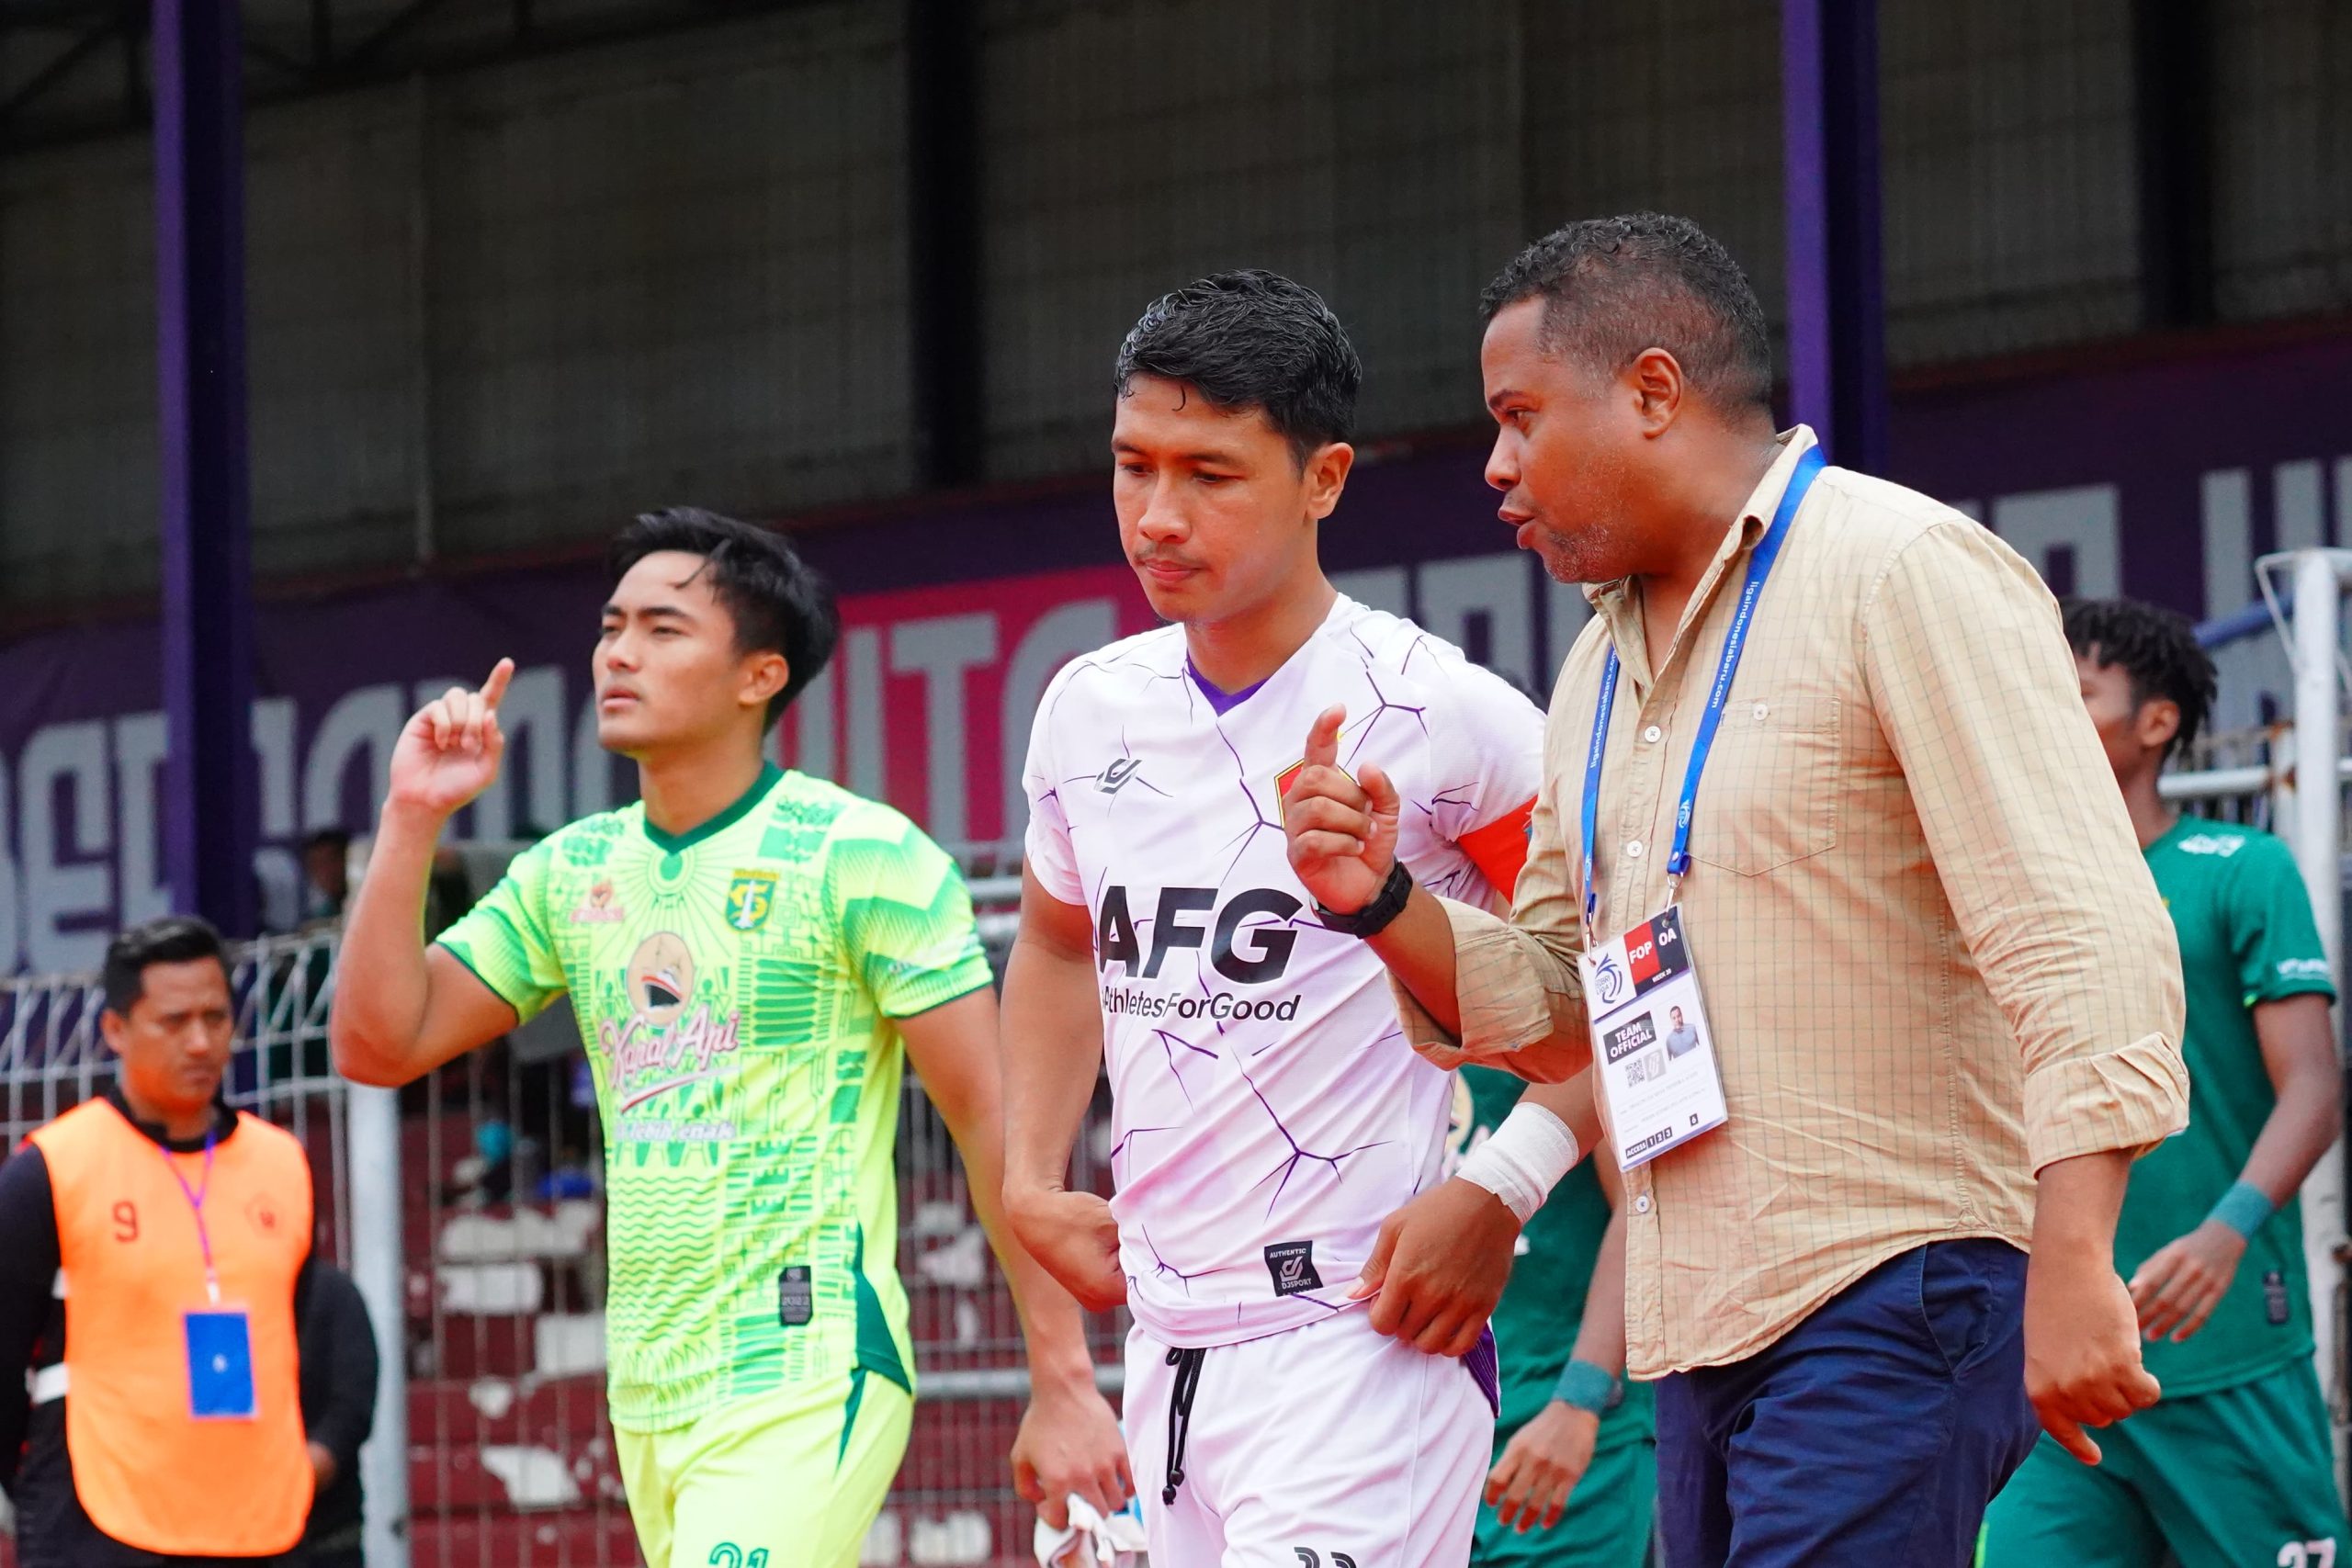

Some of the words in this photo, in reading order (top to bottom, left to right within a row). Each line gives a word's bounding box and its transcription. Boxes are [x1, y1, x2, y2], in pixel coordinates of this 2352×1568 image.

[1712, 581, 1759, 708] ligaindonesiabaru.com
[1100, 886, 1303, 984] AFG
[1658, 928, 1678, 946] OA
[1629, 941, 1653, 964] FOP
[670, 1003, 740, 1071] Api
[1615, 1021, 1643, 1043] TEAM
[1610, 1030, 1653, 1058] OFFICIAL
[1625, 1141, 1647, 1157] ACCESS
[113, 1201, 140, 1244] 9
[1270, 1248, 1307, 1259] AUTHENTIC
[1282, 1278, 1312, 1290] DJSPORT
